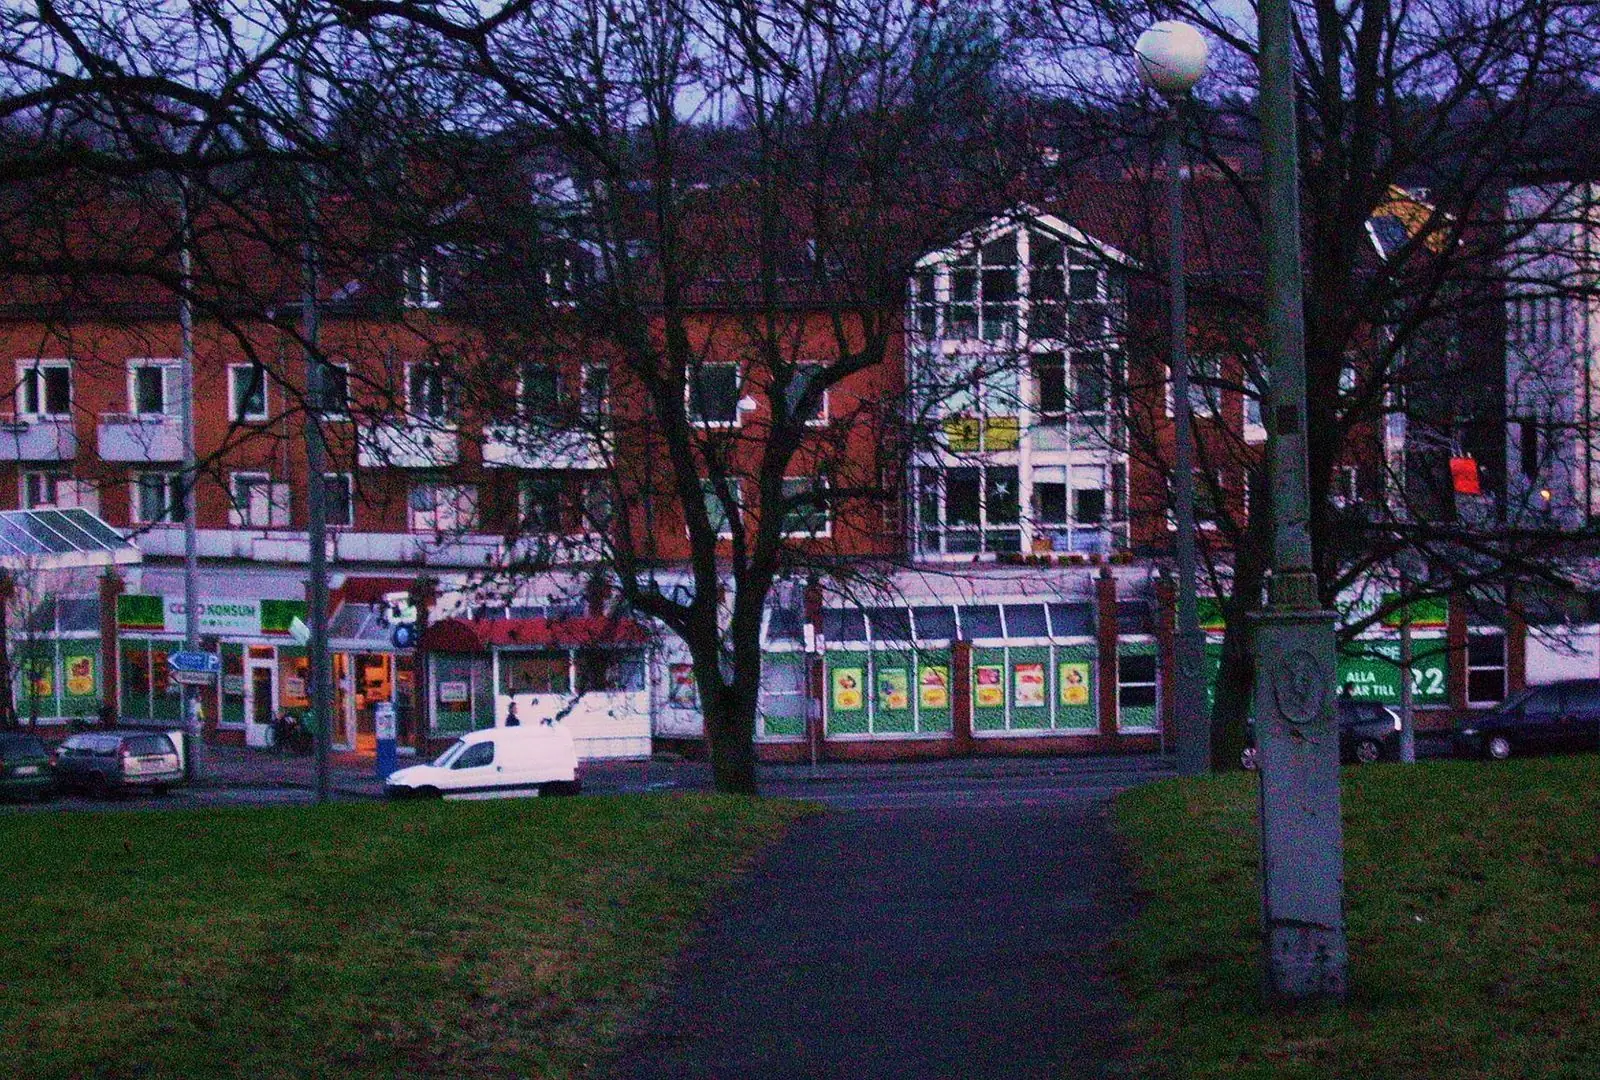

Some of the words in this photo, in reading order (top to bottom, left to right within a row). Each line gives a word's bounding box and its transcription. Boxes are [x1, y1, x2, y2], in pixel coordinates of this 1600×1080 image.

[208, 654, 219, 670] P
[1346, 672, 1376, 683] ALLA
[1410, 667, 1445, 695] 22
[1372, 684, 1396, 697] TILL
